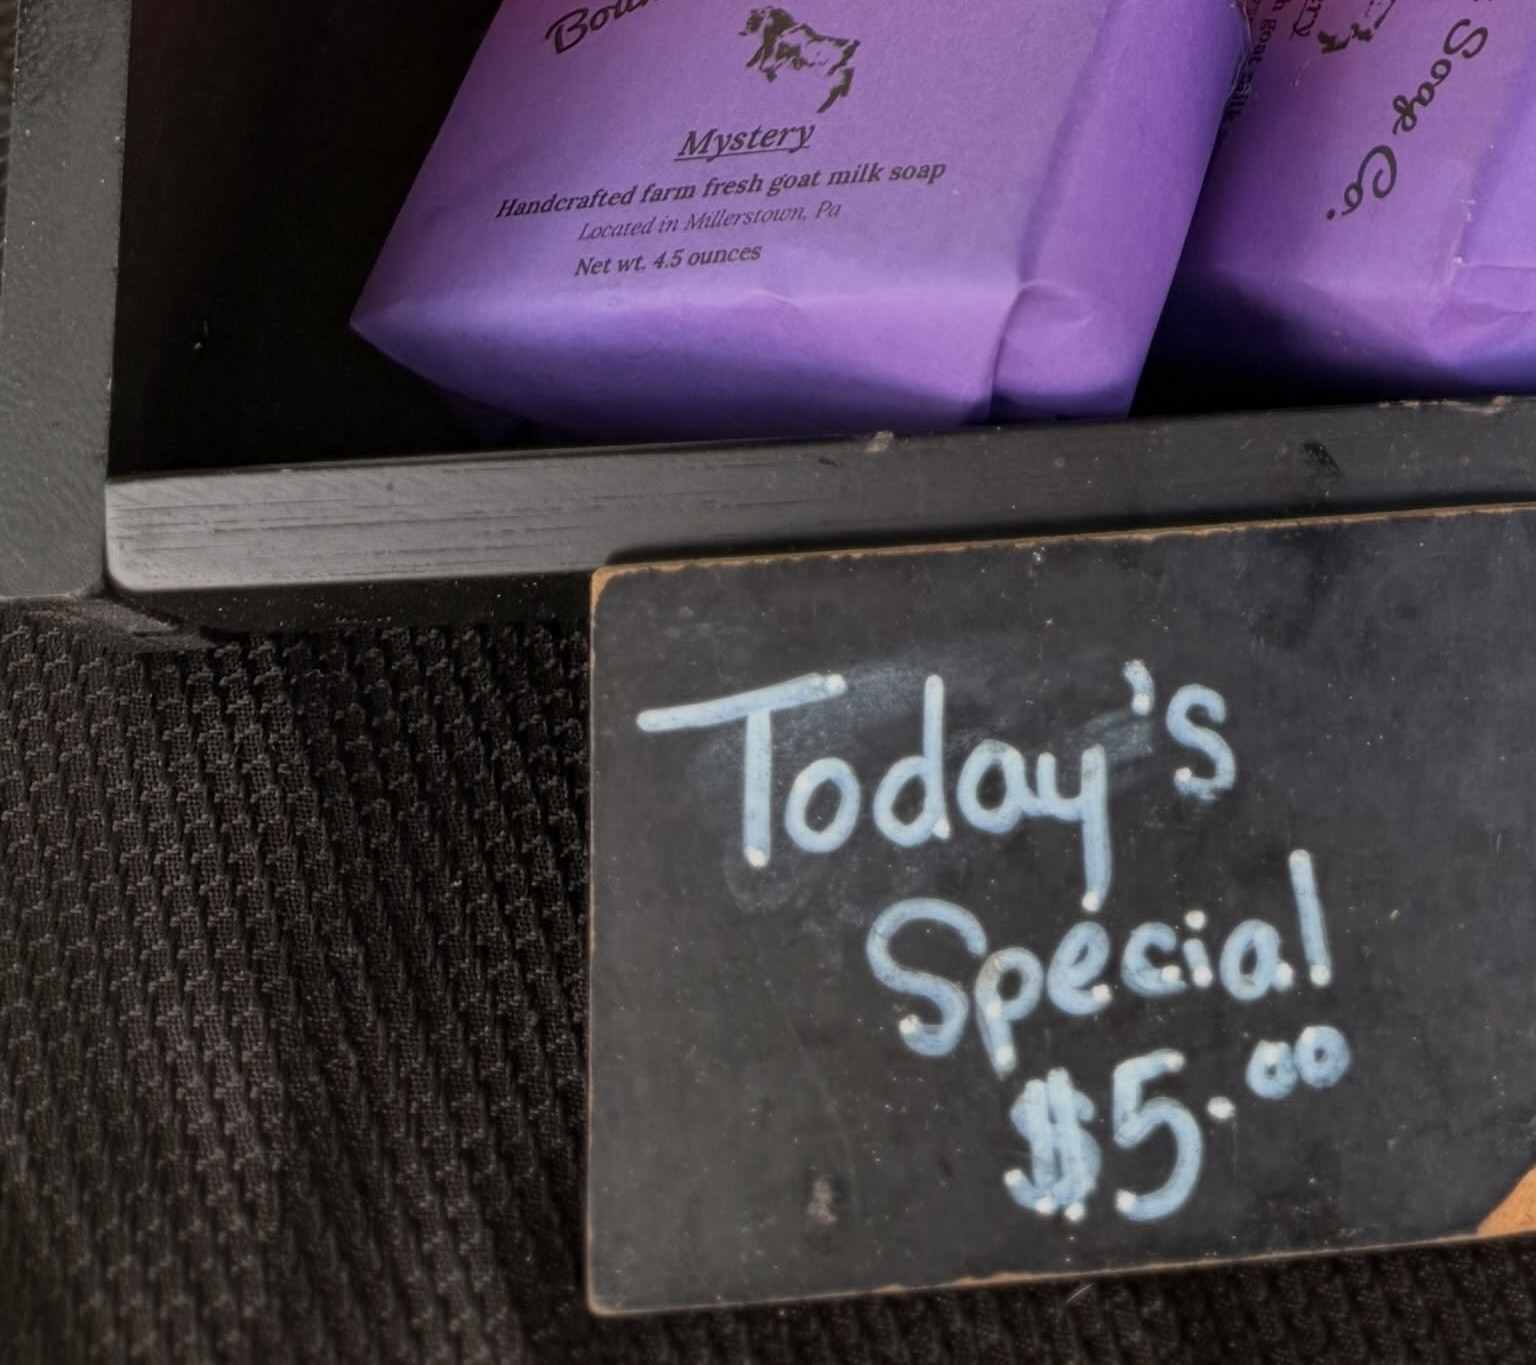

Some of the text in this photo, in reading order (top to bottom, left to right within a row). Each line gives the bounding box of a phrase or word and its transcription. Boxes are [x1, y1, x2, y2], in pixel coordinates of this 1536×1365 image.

[1392, 18, 1488, 135] Soap
[673, 123, 816, 162] Mystery
[497, 159, 946, 218] Handcrafted farm fresh goat milk soap
[1327, 145, 1397, 220] Co.
[578, 200, 841, 241] Located in Millerstown, Pa
[575, 244, 761, 276] Net wt. 4.5 ounces
[636, 659, 1238, 912] Today's
[865, 848, 1333, 1075] Special
[1004, 1025, 1352, 1223] $5.00
